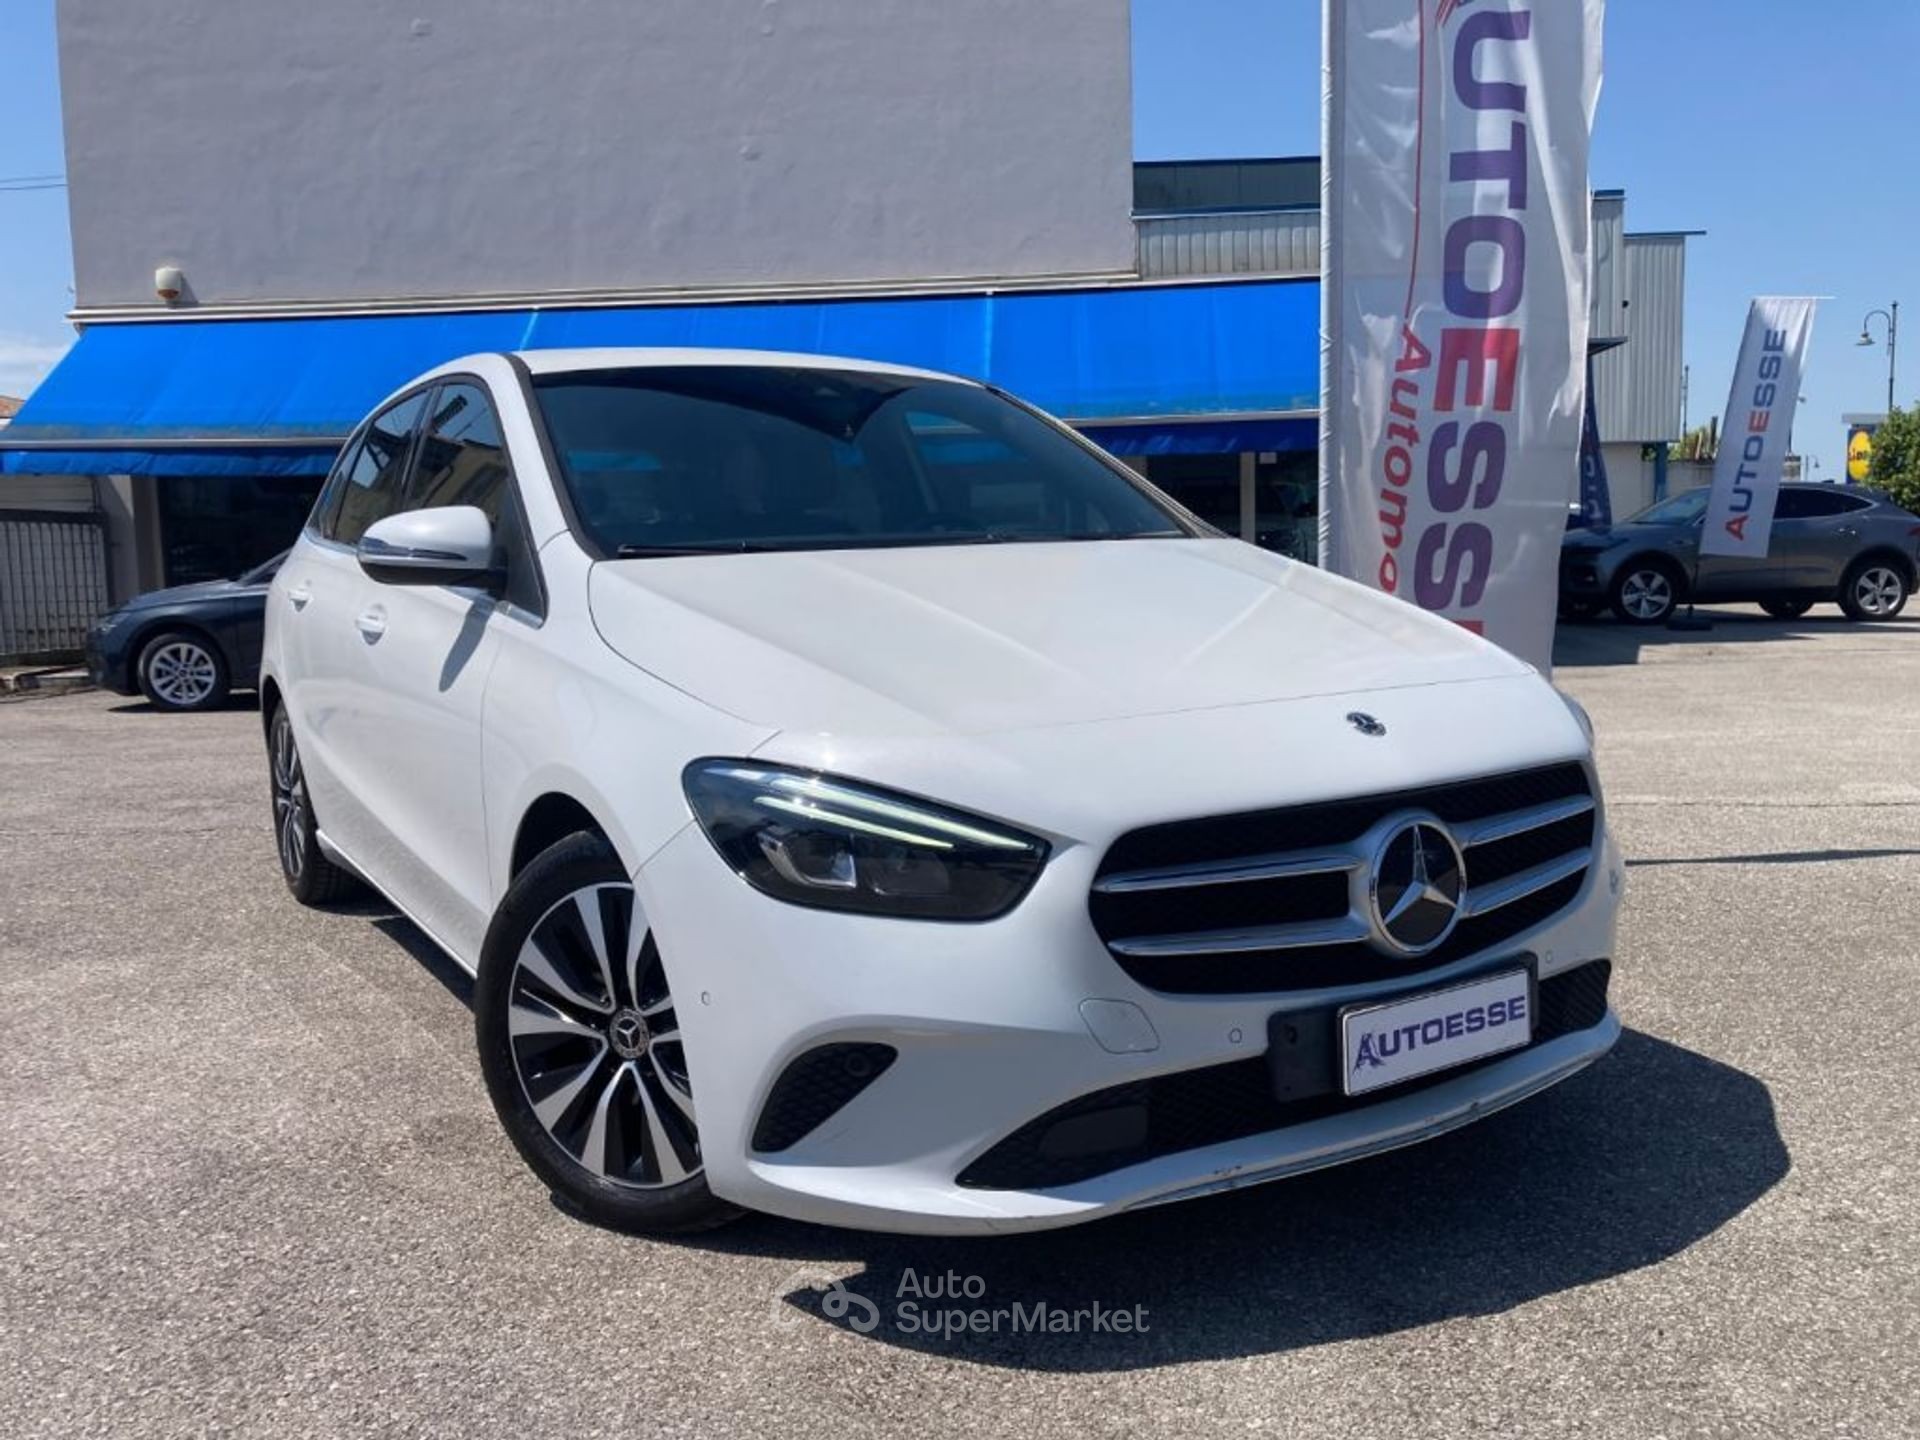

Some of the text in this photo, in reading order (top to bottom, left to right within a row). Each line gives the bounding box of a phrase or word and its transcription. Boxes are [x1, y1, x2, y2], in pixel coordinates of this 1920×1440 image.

[1413, 0, 1531, 638] UTOESS
[1725, 329, 1787, 541] AUTOESSE
[1353, 996, 1526, 1076] AUTOESSE
